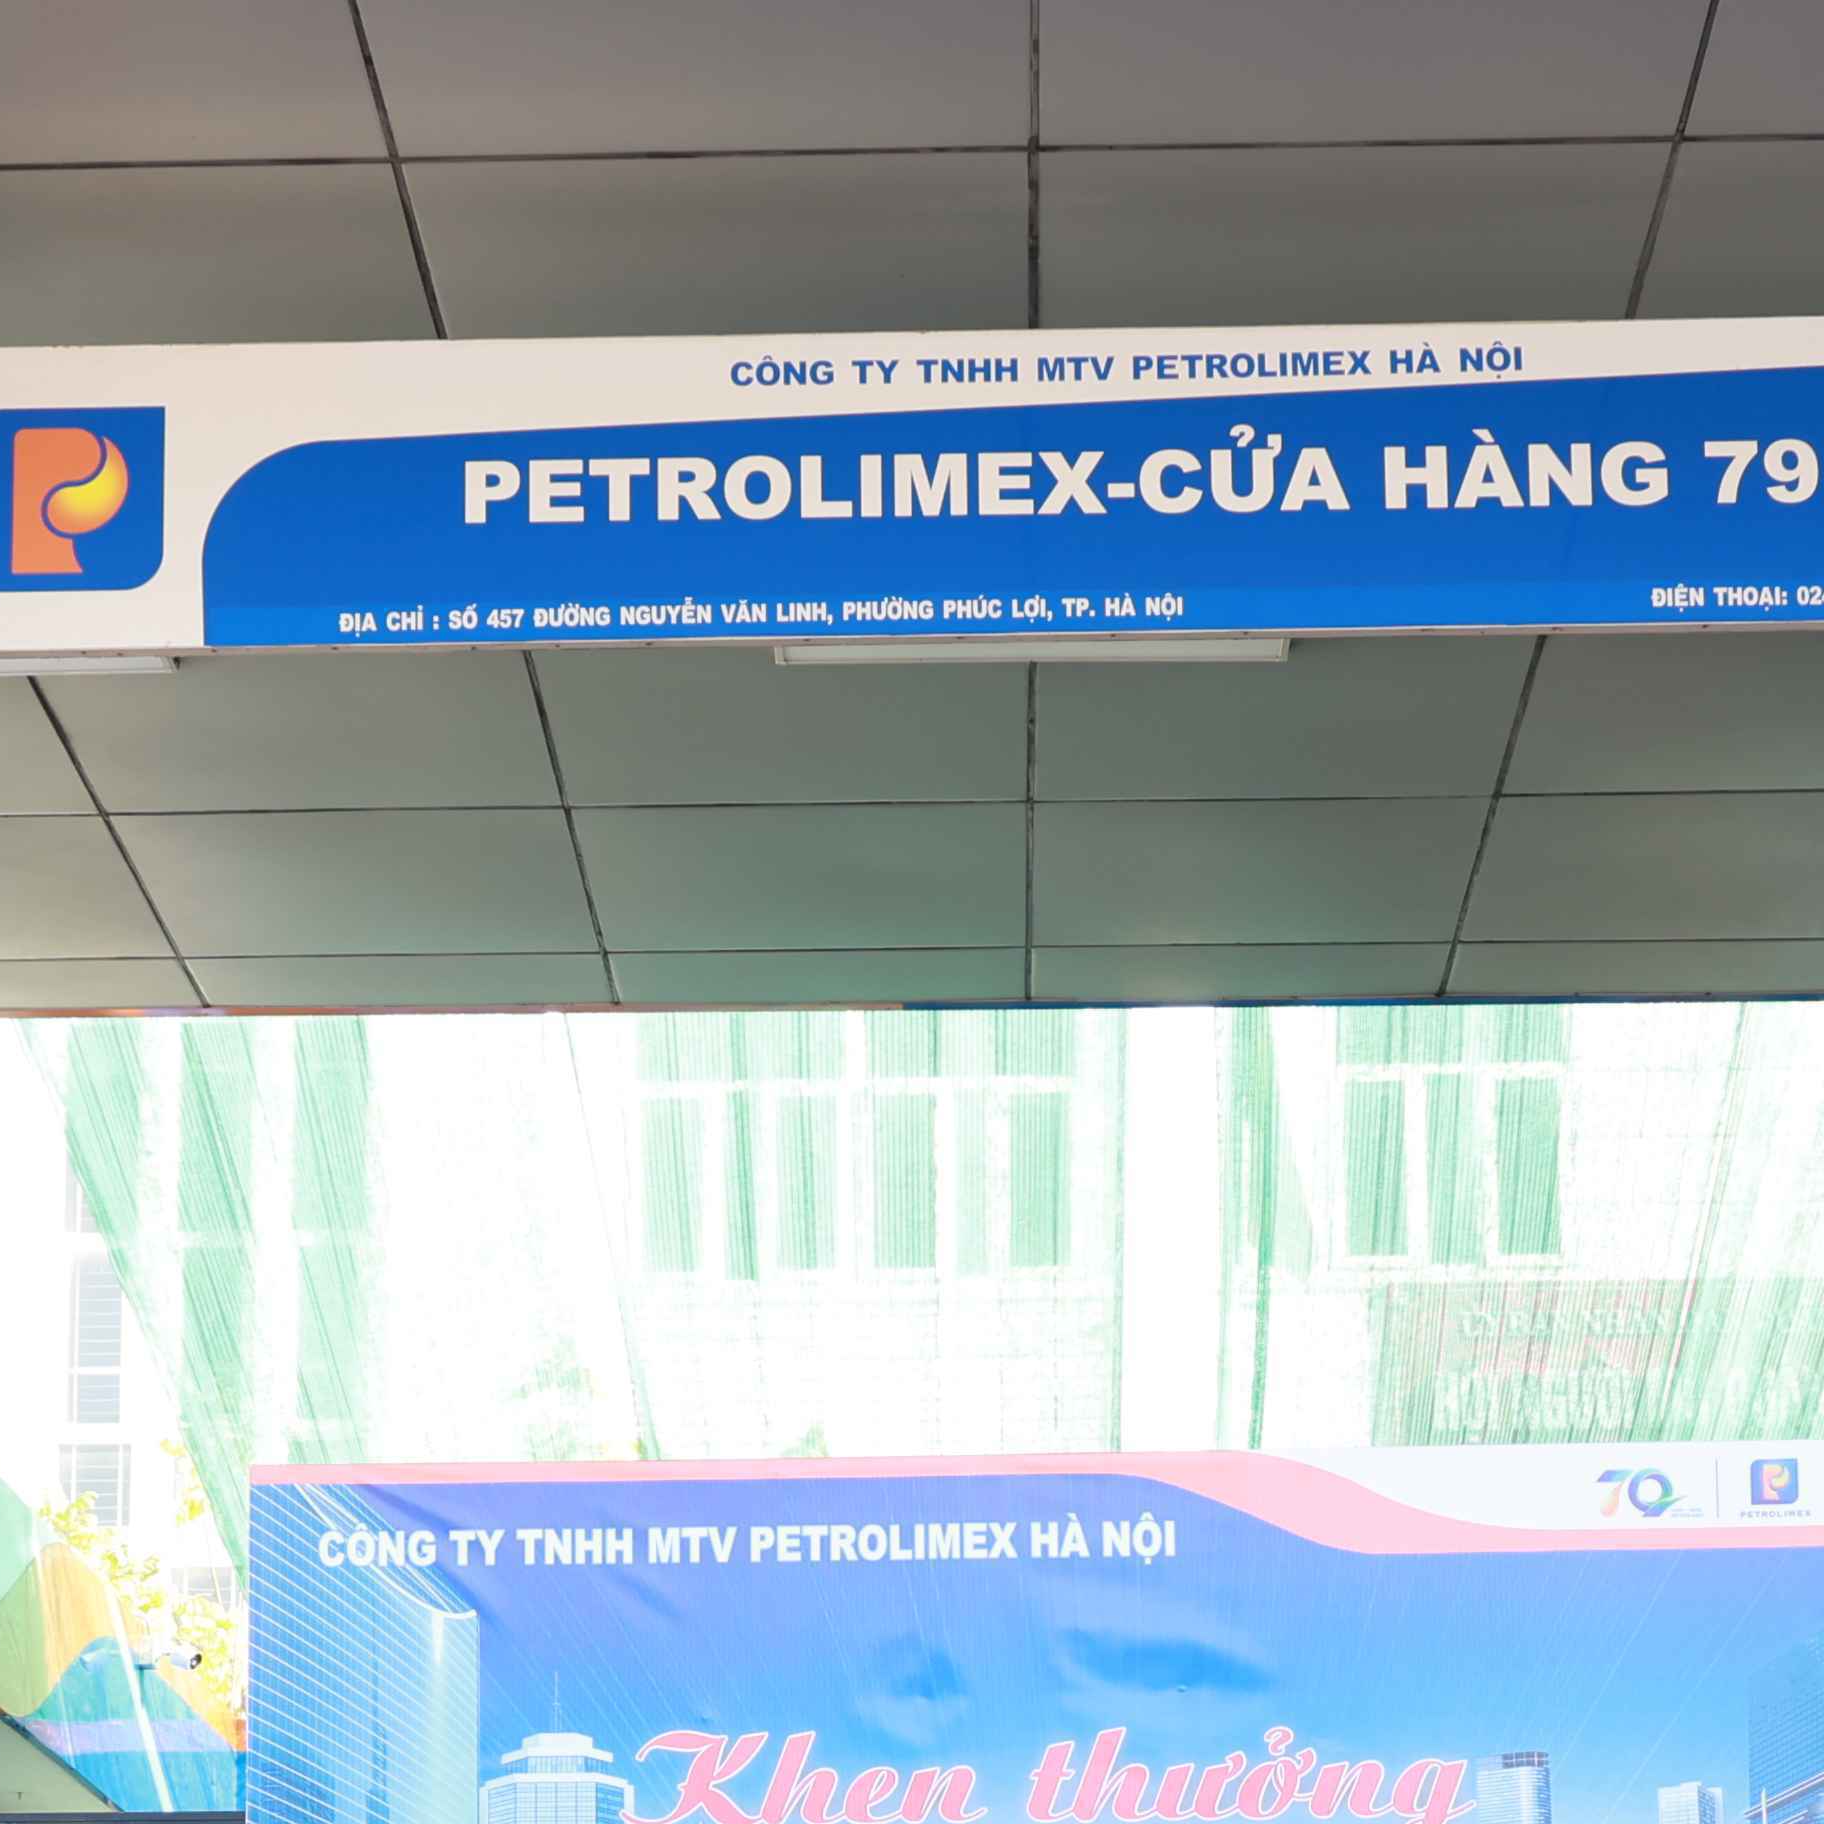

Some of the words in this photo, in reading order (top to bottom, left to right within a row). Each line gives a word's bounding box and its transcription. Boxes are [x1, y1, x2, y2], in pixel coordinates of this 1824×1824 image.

[731, 354, 835, 387] CÔNG
[851, 359, 901, 385] TY
[917, 357, 1020, 384] TNHH
[1036, 355, 1115, 382] MTV
[1131, 349, 1373, 380] PETROLIMEX
[1388, 341, 1441, 374] HÀ
[1458, 341, 1524, 380] NỘI
[463, 423, 1351, 525] PETROLIMEX-CỬA
[1382, 427, 1670, 511] HÀNG
[1703, 437, 1820, 506] 79
[338, 611, 378, 638] ĐỊA
[385, 603, 425, 633] CHỈ
[448, 602, 478, 631] SỐ
[486, 608, 525, 630] 457
[532, 601, 612, 628] ĐƯỜNG
[619, 596, 713, 627] NGUYỄN
[720, 597, 768, 624] VĂN
[775, 601, 834, 627] LINH,
[842, 595, 935, 622] PHƯỜNG
[942, 594, 1004, 620] PHÚC
[1011, 596, 1054, 624] LỢI,
[1061, 597, 1096, 619] TP.
[1104, 591, 1137, 618] HÀ
[1144, 593, 1185, 623] NỘI
[1650, 582, 1706, 613] ĐIỆN
[1712, 586, 1789, 612] THOẠI:
[317, 1523, 437, 1568] CÔNG
[448, 1529, 505, 1567] TY
[515, 1527, 634, 1566] TNHH
[647, 1526, 738, 1565] MTV
[749, 1520, 1018, 1563] PETROLIMEX
[1029, 1511, 1090, 1558] HÀ
[1101, 1511, 1177, 1566] NỘI
